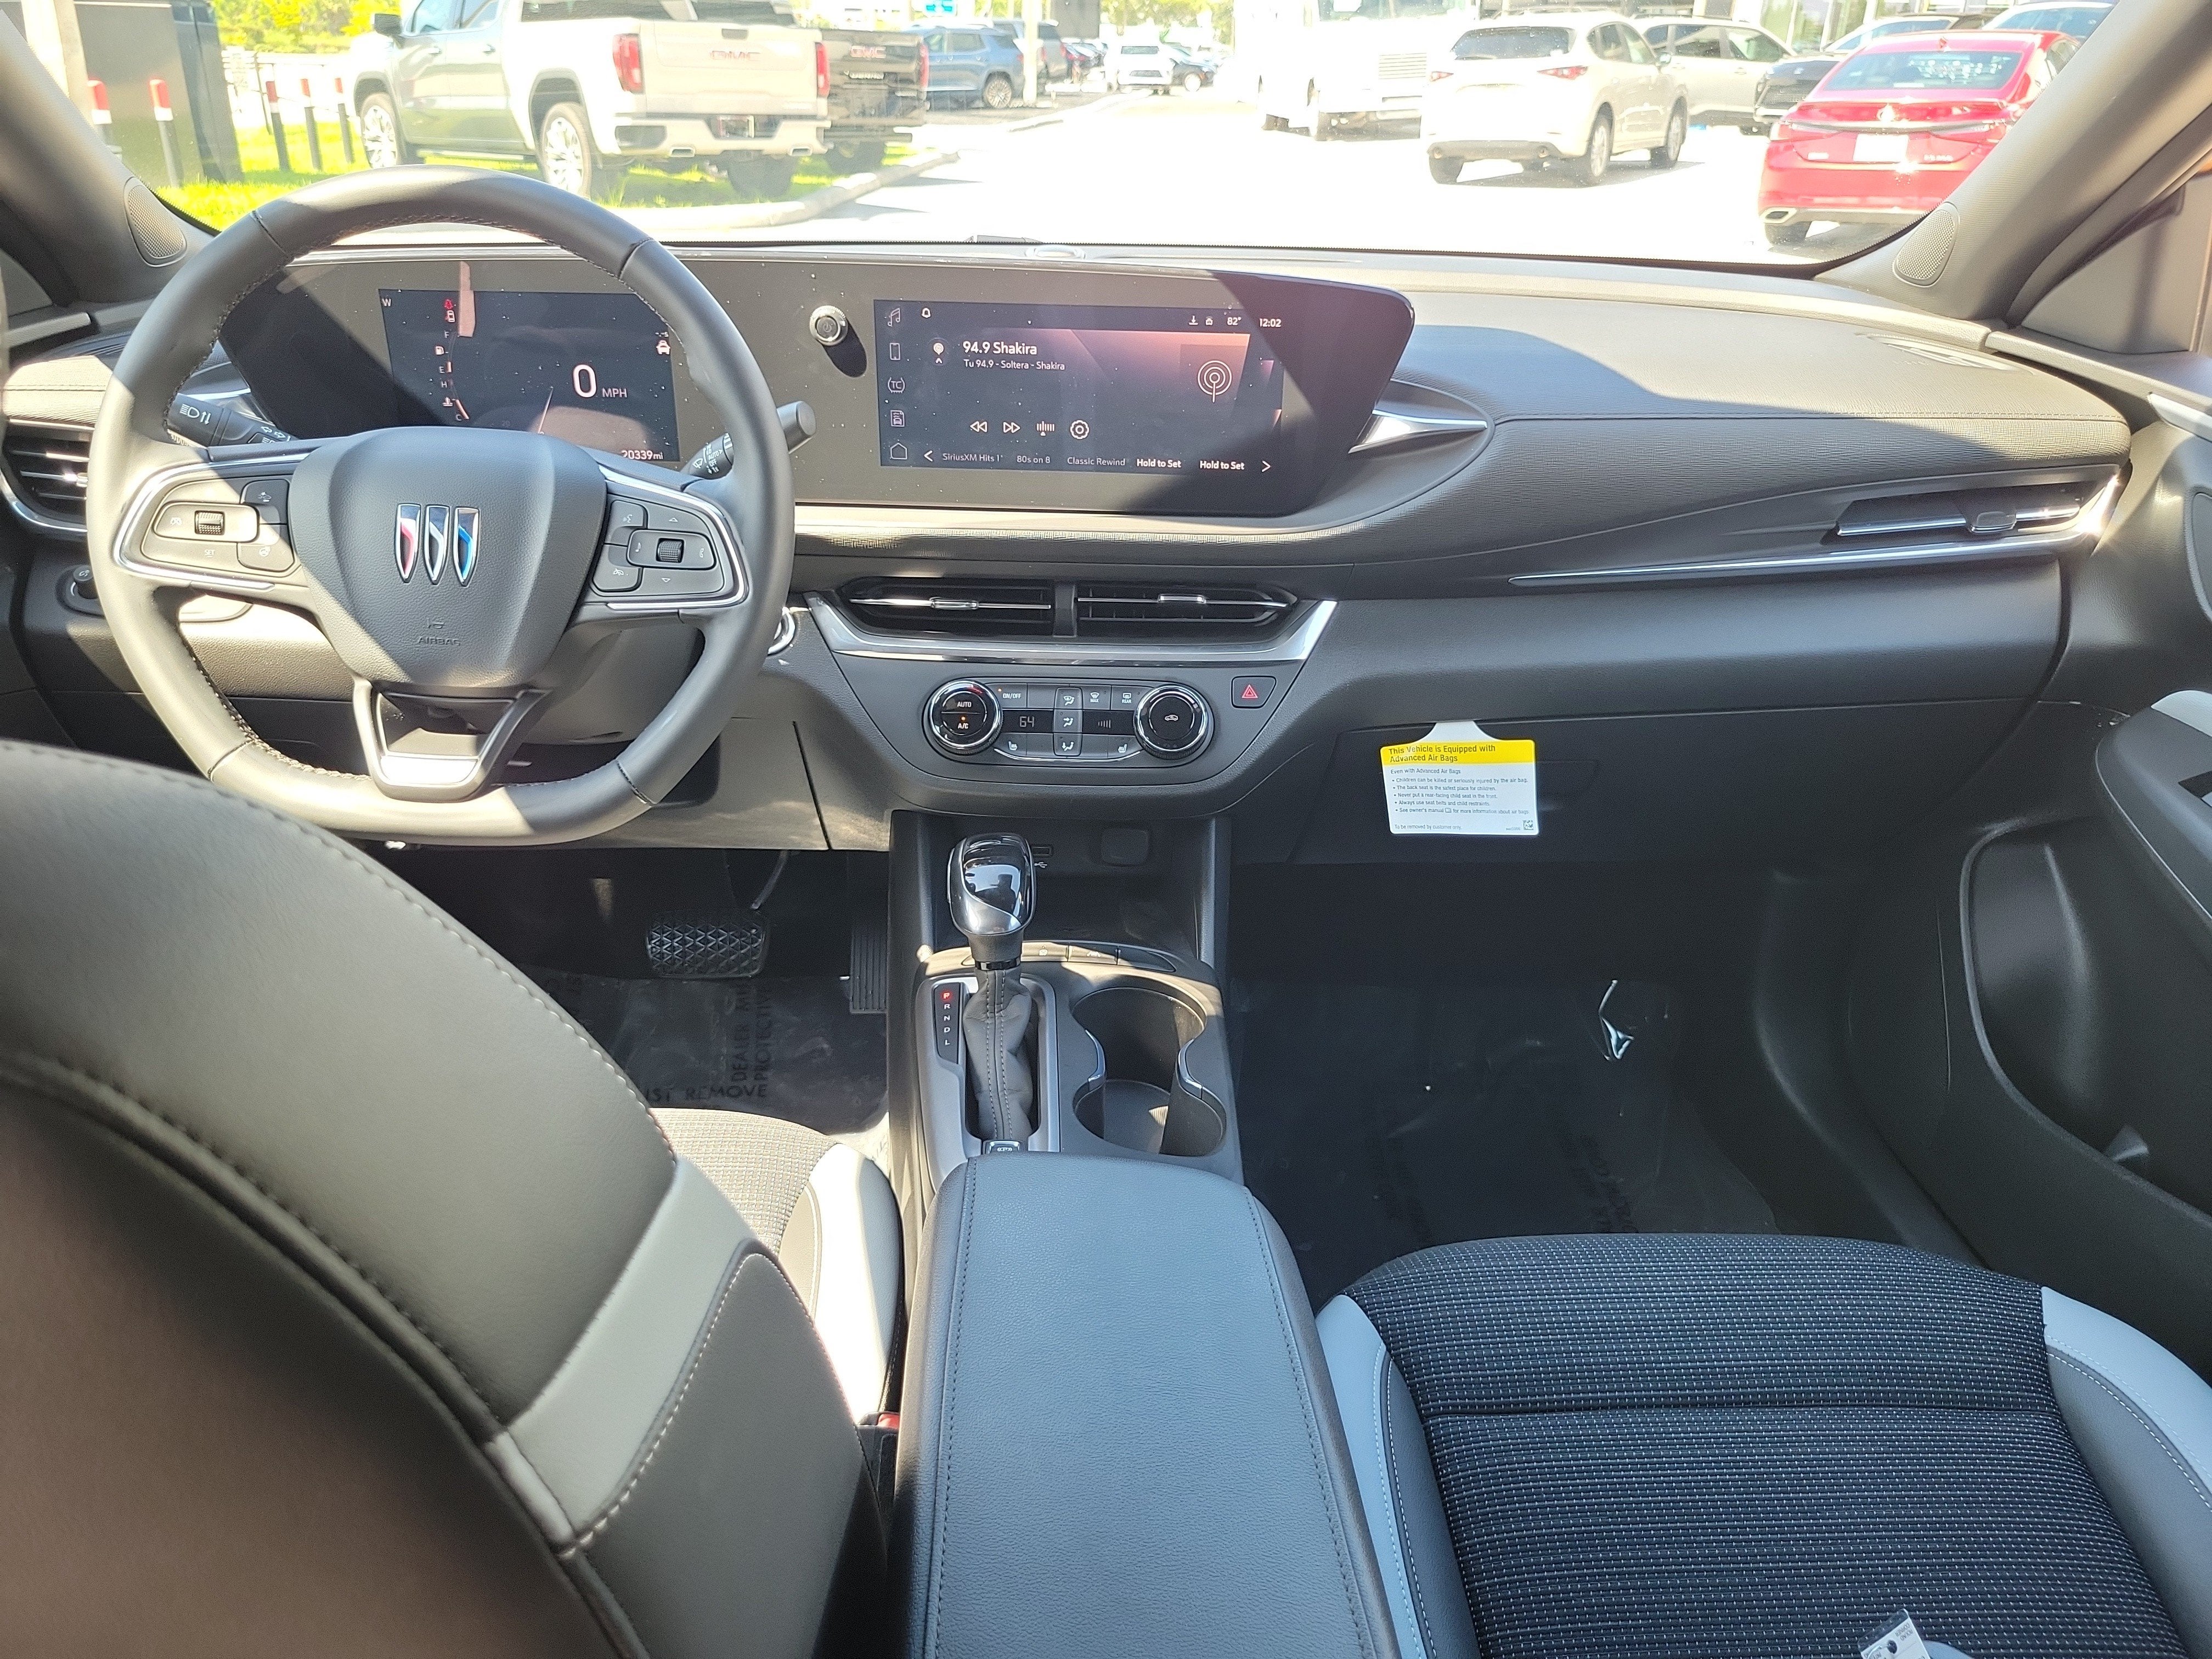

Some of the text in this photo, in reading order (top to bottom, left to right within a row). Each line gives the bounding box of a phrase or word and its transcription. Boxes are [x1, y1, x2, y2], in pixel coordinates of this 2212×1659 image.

[382, 298, 392, 307] W
[1227, 317, 1242, 325] 82°
[1259, 318, 1282, 328] 12:02
[963, 341, 1037, 355] 94.9 Shakira
[963, 359, 974, 368] Tu
[975, 359, 994, 368] 94.9
[1001, 360, 1029, 369] Soltera
[1036, 361, 1065, 370] Shakira
[573, 364, 628, 398] 0 MPH
[943, 453, 977, 462] SiriusXM
[979, 454, 995, 462] Hits
[1067, 457, 1125, 466] Classic Rewind
[1137, 459, 1182, 468] Hold to Set
[1200, 460, 1219, 469] Hold
[1231, 461, 1245, 470] Set
[1019, 716, 1035, 727] 64
[1443, 745, 1477, 754] Equipped
[1390, 754, 1426, 763] Advanced
[1440, 754, 1458, 763] Bags
[685, 1084, 769, 1100] REMOVE
